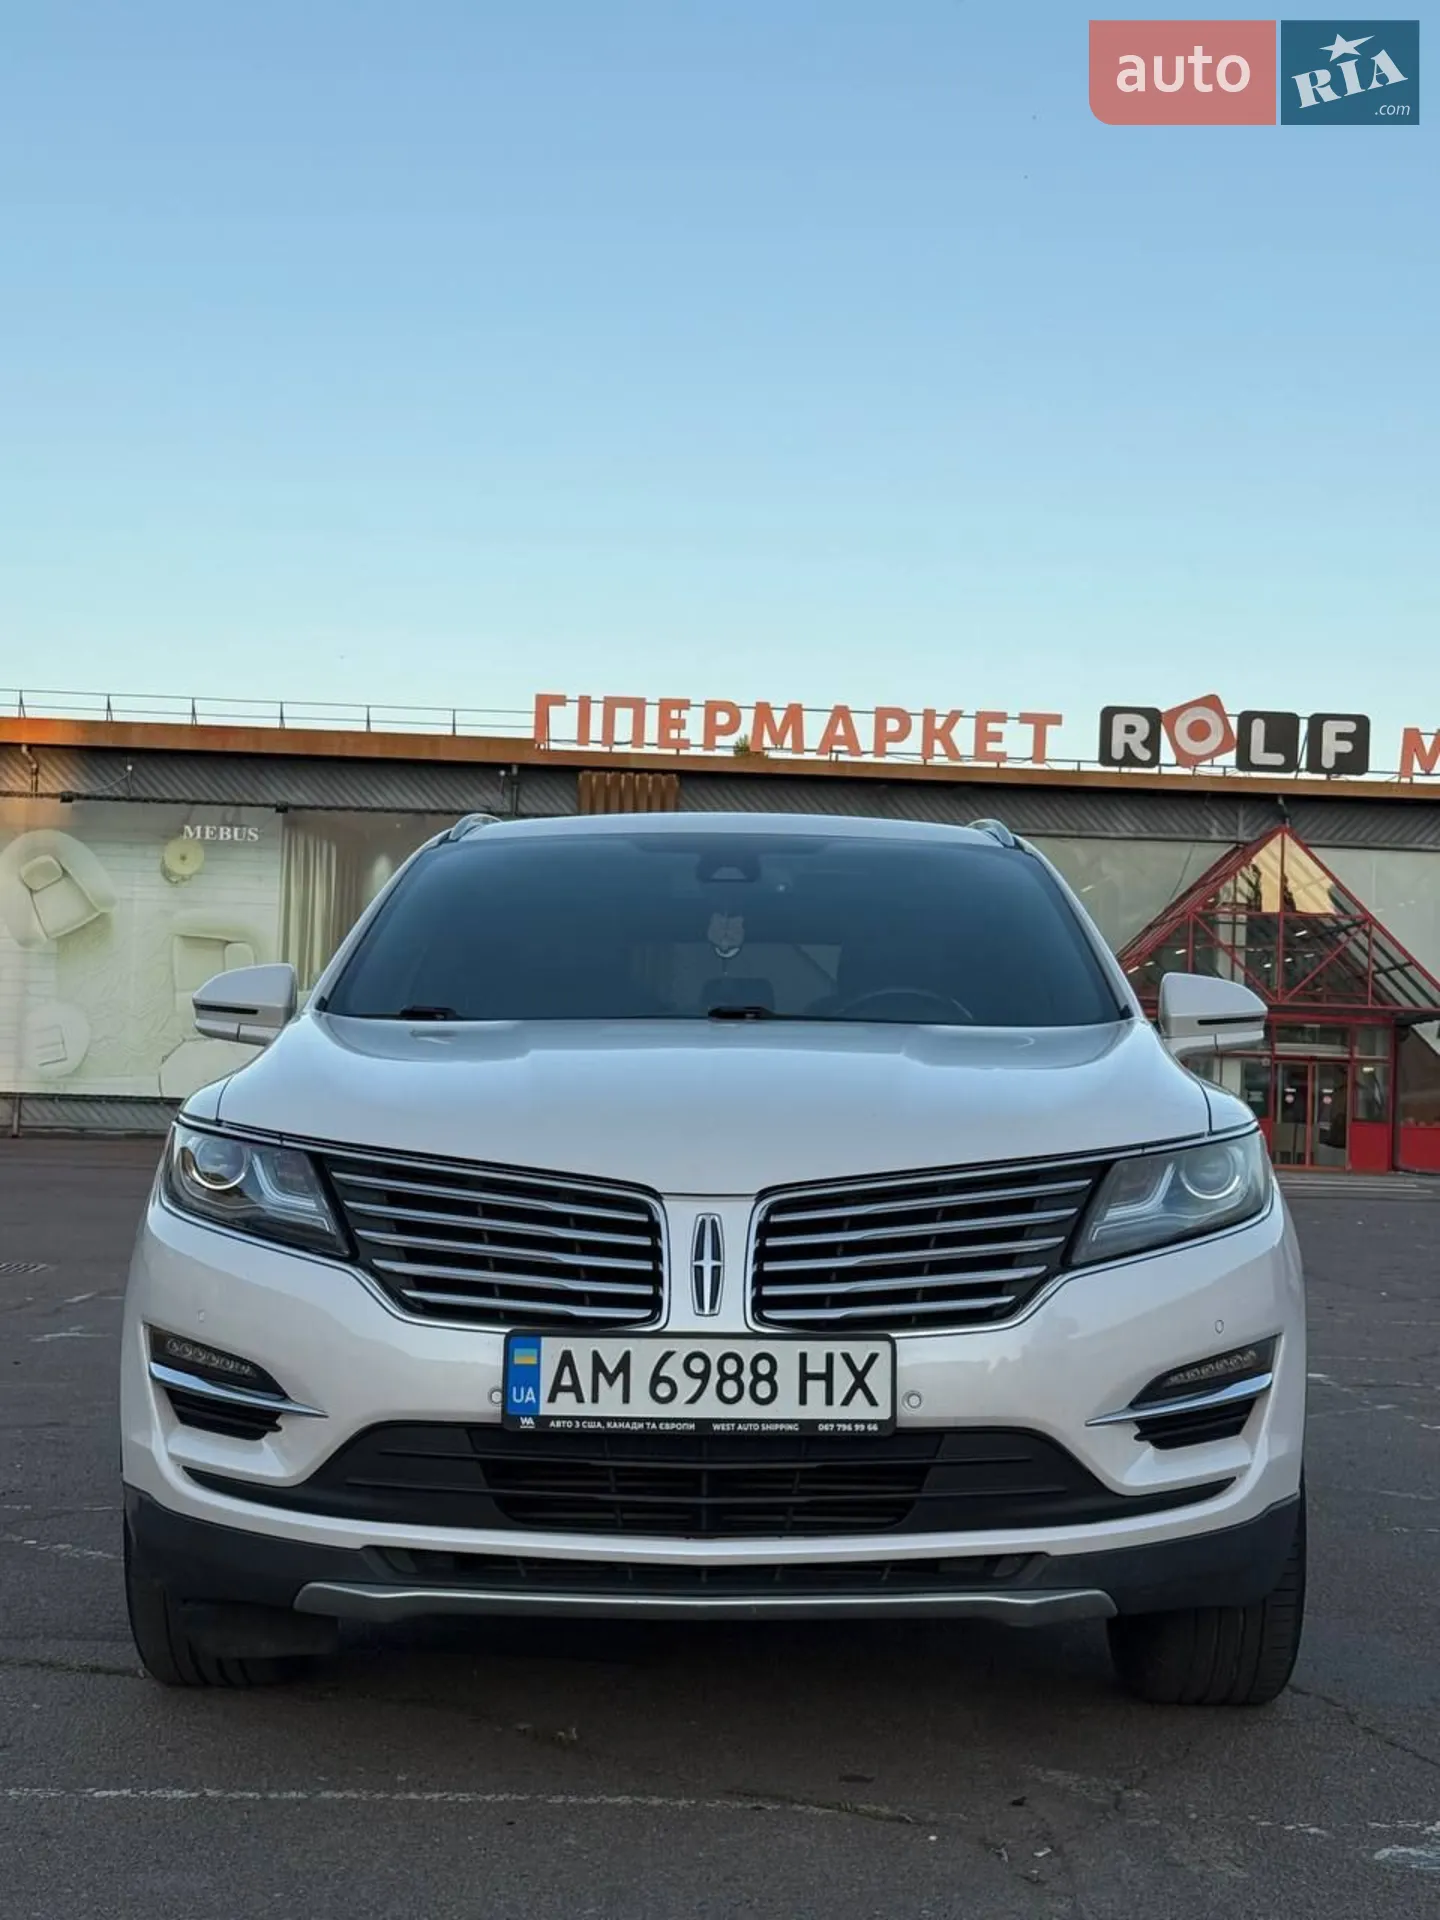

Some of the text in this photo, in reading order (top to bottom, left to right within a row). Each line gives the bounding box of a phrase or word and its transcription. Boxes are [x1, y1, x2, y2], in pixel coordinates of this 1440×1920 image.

[533, 693, 1063, 765] ГІПЕРМАРКЕТ
[1110, 705, 1358, 769] ROLF
[182, 825, 260, 842] MEBUS
[546, 1349, 880, 1407] AM 6988 HX
[512, 1386, 537, 1404] UA
[549, 1420, 573, 1428] АВТО
[712, 1423, 800, 1431] WEST AUTO SHIPPING
